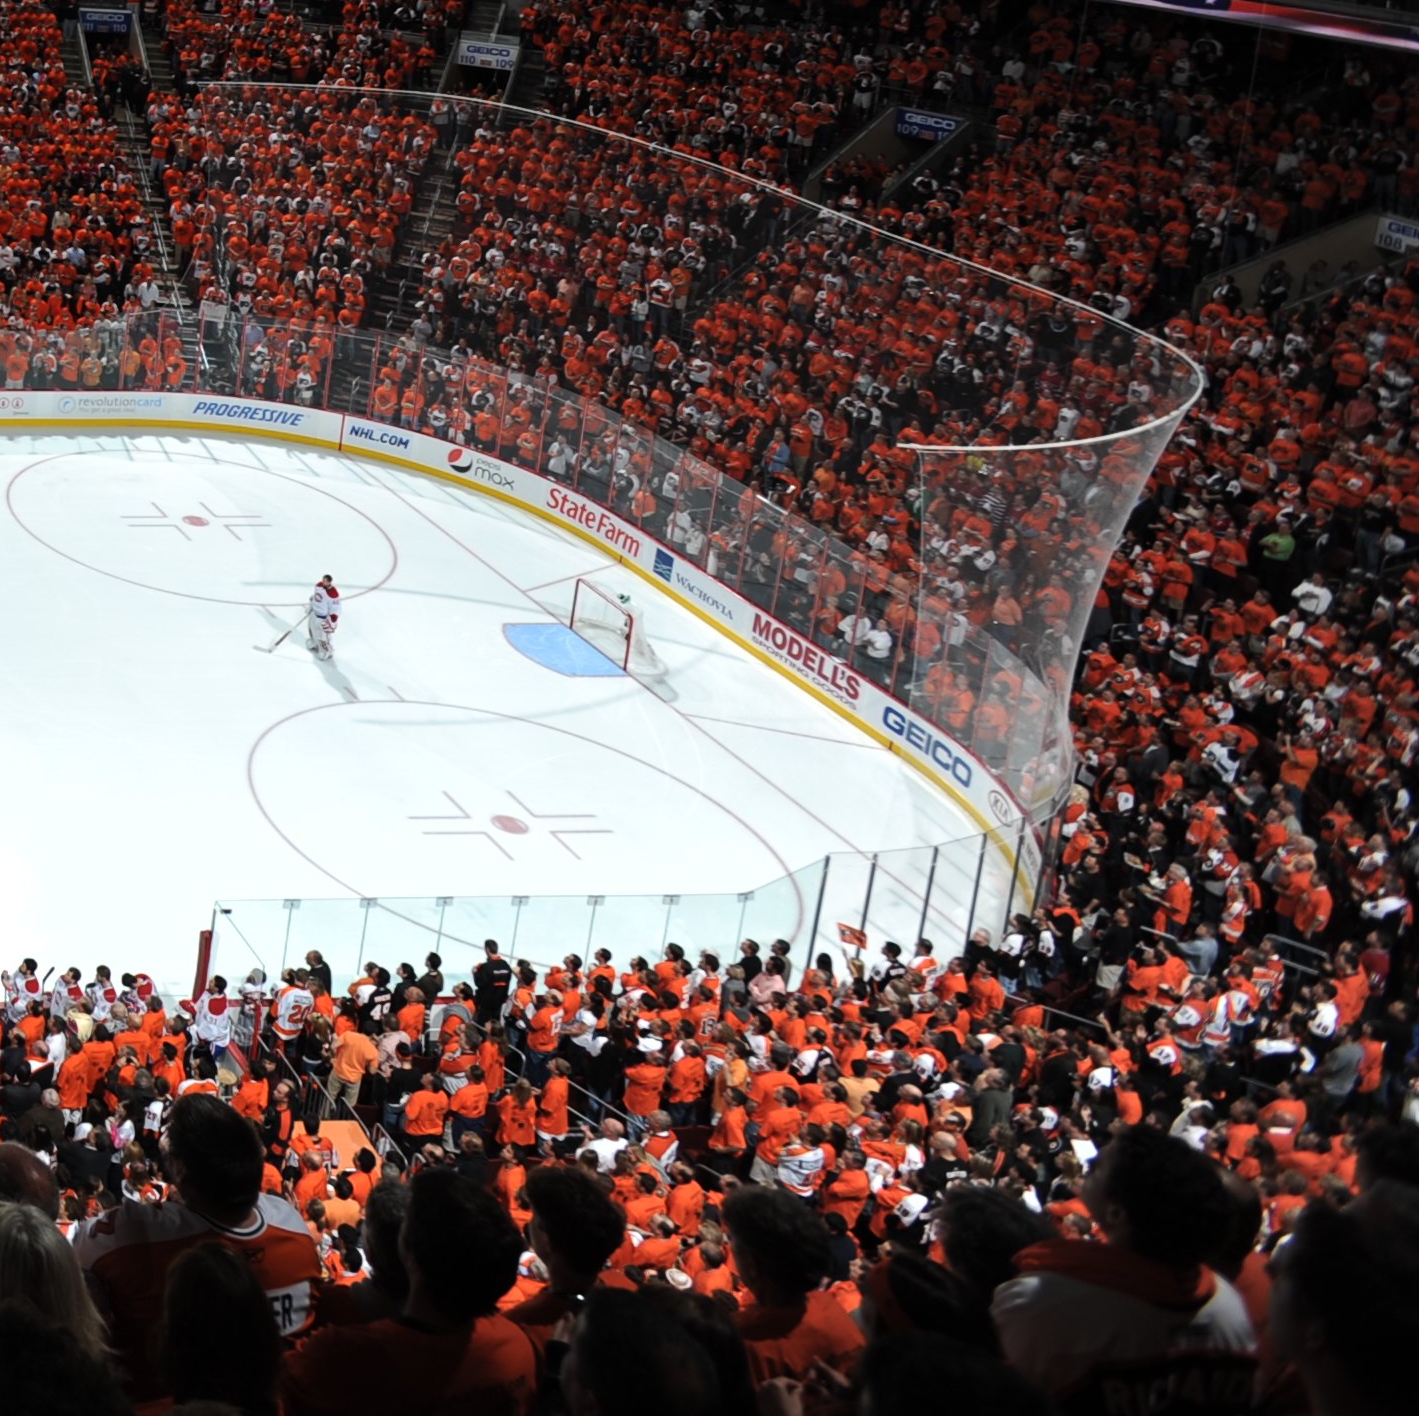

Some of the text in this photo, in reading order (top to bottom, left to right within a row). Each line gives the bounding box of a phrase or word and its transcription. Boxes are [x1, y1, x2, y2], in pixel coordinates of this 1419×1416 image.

[86, 13, 125, 22] GEICO
[113, 24, 127, 33] 110
[460, 55, 476, 65] 110
[466, 44, 510, 57] GEICO
[897, 124, 918, 137] 109
[904, 112, 956, 129] GEICO
[1378, 233, 1402, 250] 108
[78, 396, 162, 408] revolutioncard
[193, 401, 305, 426] PROGRESSIVE
[349, 424, 410, 450] NHL.COM
[476, 458, 501, 471] pepsi
[474, 465, 514, 490] max
[546, 488, 640, 557] State Farm
[676, 572, 734, 621] WACHOVIA
[751, 611, 861, 701] MODELL'S
[751, 635, 811, 678] SPORTING
[882, 706, 972, 787] GEICO
[990, 794, 1012, 823] KIA
